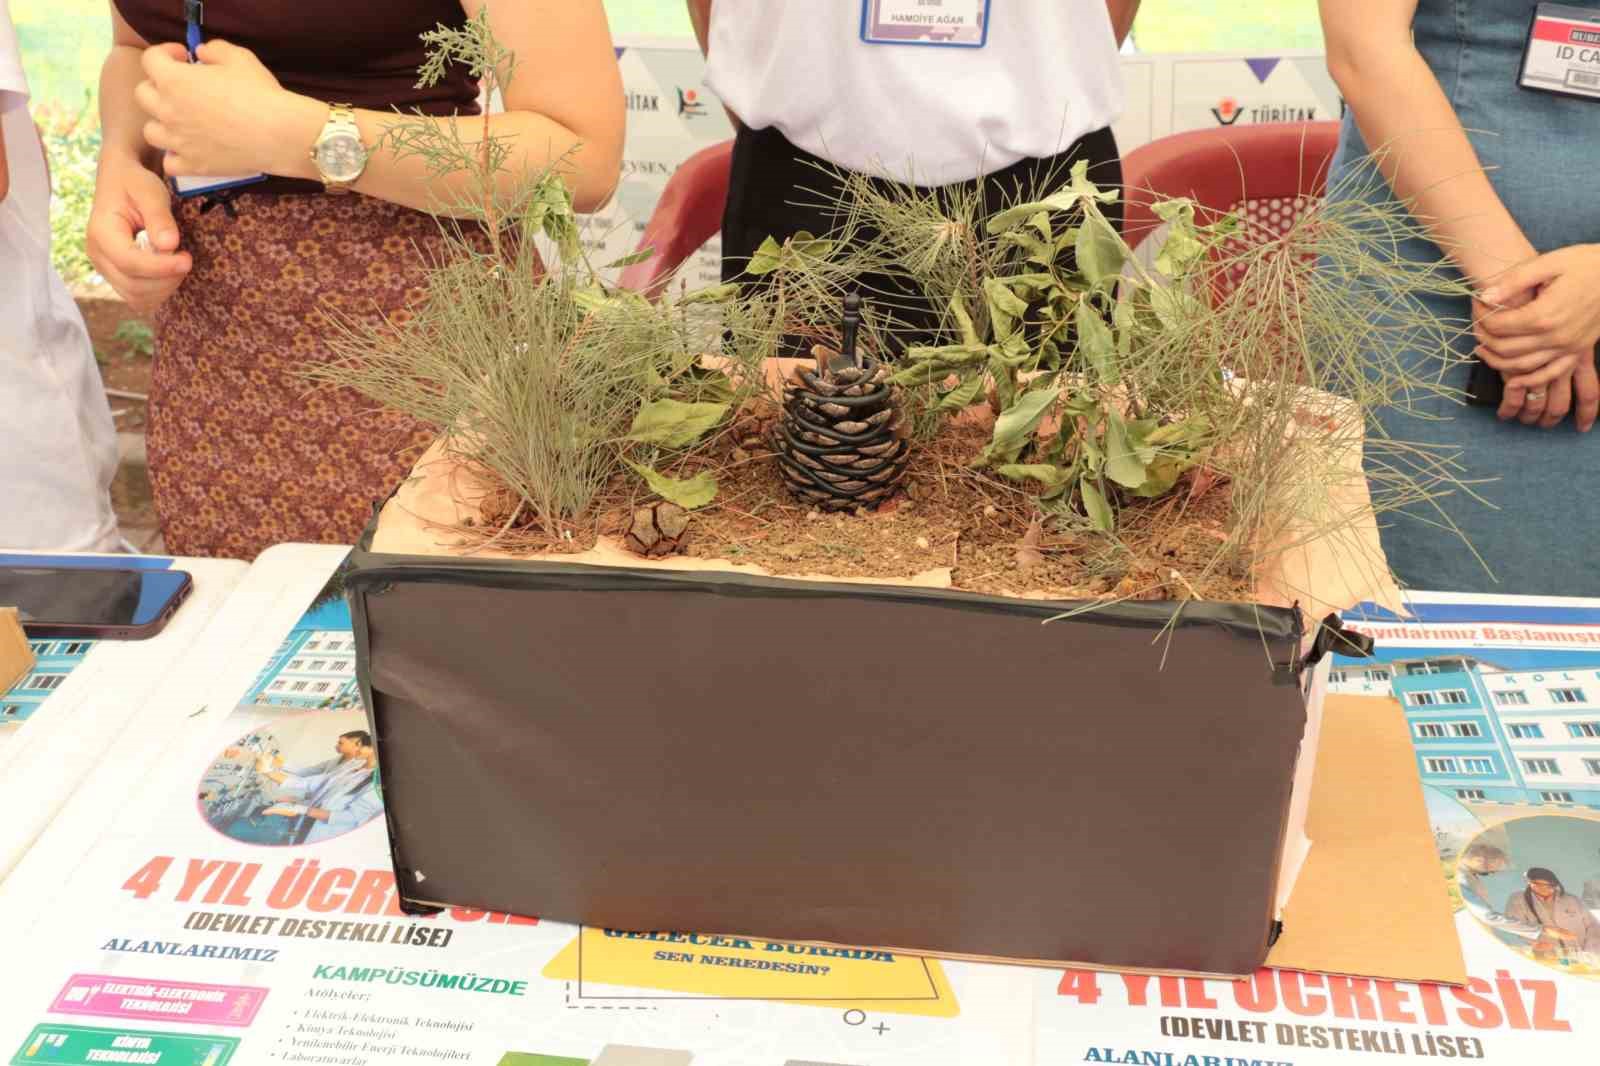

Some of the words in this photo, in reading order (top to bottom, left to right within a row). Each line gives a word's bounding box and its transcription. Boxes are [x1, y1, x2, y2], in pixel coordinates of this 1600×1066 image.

[1555, 45, 1575, 60] ID
[1578, 48, 1600, 65] CA
[120, 855, 176, 900] 4
[174, 858, 264, 907] YIL
[183, 911, 280, 936] (DEVLET
[277, 917, 392, 944] DESTEKLİ
[390, 923, 454, 948] LİSE)
[101, 937, 281, 963] ALANLARIMIZ
[653, 950, 694, 963] SEN
[700, 956, 832, 976] NEREDESİN?
[312, 963, 529, 997] KAMPÜSÜMÜZDE
[1056, 967, 1103, 1005] 4
[1119, 972, 1219, 1010] YIL
[1159, 1015, 1269, 1044] (DEVLET
[1275, 1022, 1407, 1055] DESTEKLİ
[1411, 1030, 1486, 1059] LİSE)
